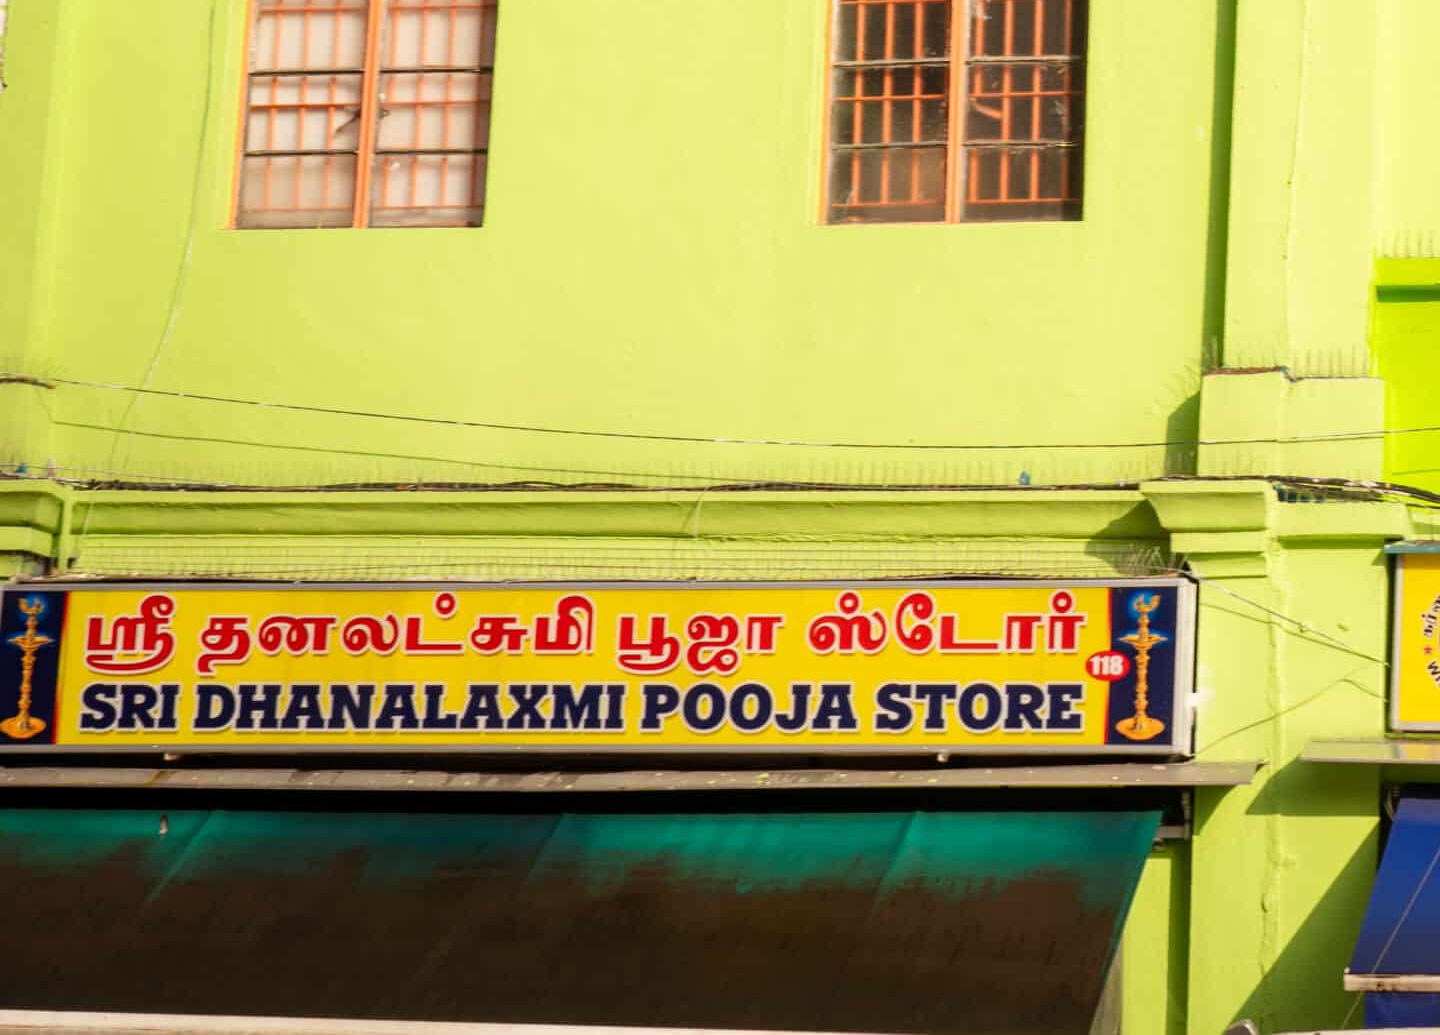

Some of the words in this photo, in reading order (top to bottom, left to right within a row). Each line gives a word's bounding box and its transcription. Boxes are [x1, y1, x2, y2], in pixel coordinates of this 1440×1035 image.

[87, 596, 173, 670] ஸ்ரீ
[198, 594, 592, 672] தனலட்சுமி
[619, 616, 781, 671] பூஜா
[810, 592, 1083, 650] ஸ்டோர்
[1088, 654, 1123, 676] 118
[81, 684, 178, 729] SRI
[195, 685, 624, 728] DHANALAXMI
[642, 684, 856, 729] POOJA
[877, 684, 1081, 729] STORE
